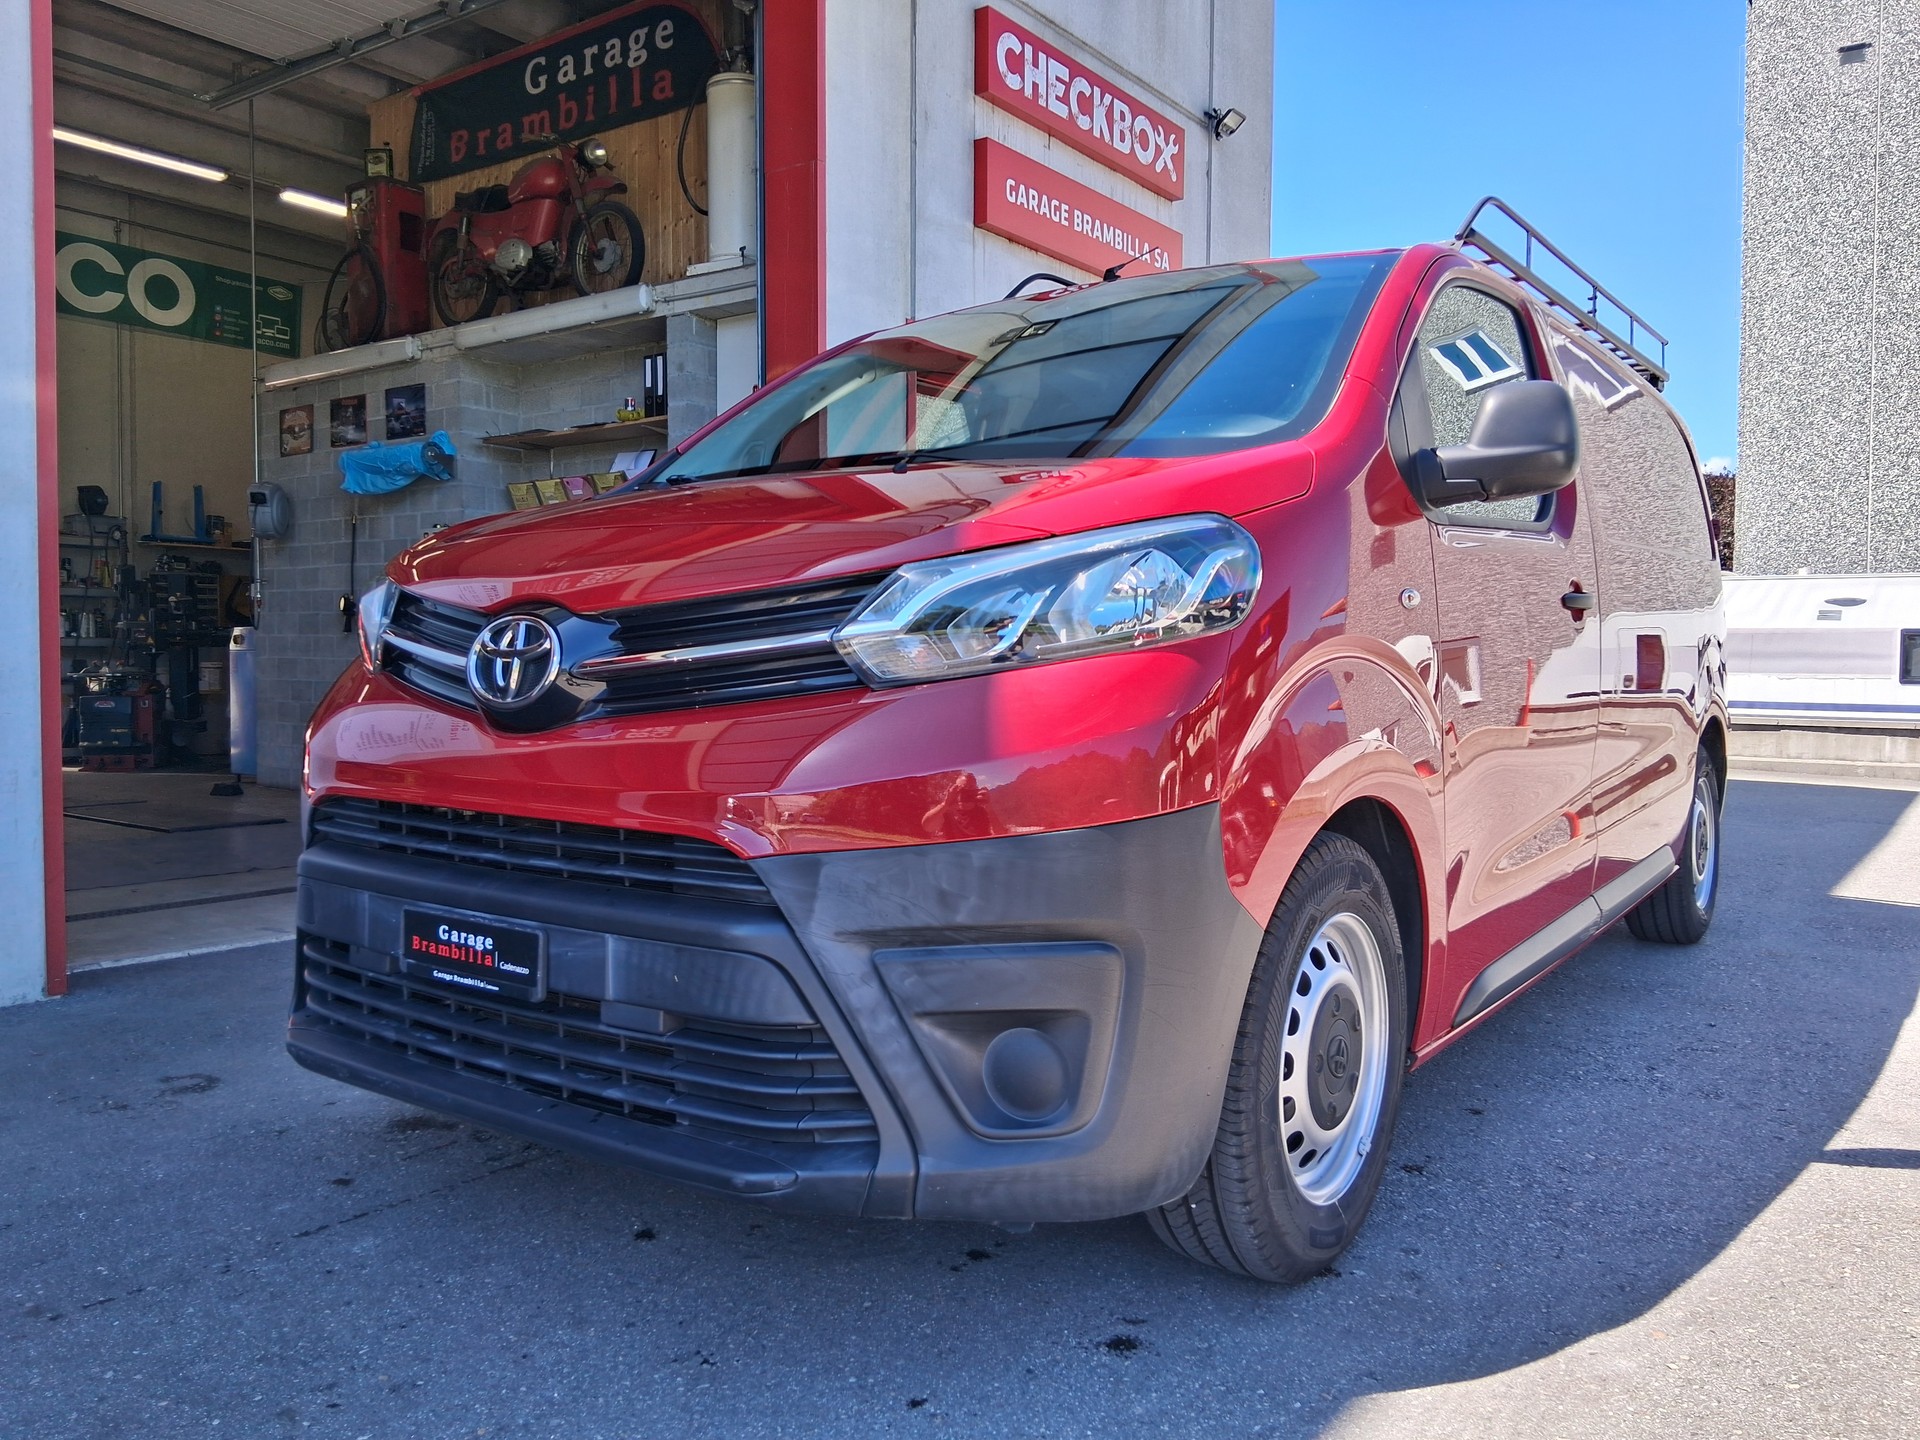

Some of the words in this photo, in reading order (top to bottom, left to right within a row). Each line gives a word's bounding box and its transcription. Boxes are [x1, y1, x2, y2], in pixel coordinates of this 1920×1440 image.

[525, 19, 673, 94] Garage
[451, 66, 674, 163] Brambilla
[996, 32, 1179, 182] CHECKBOX
[1005, 178, 1069, 227] GARAGE
[1073, 209, 1151, 263] BRAMBILLA
[1154, 248, 1170, 271] SA
[256, 338, 290, 349] acco.com
[412, 935, 493, 967] Brambilla
[438, 925, 494, 951] Garage
